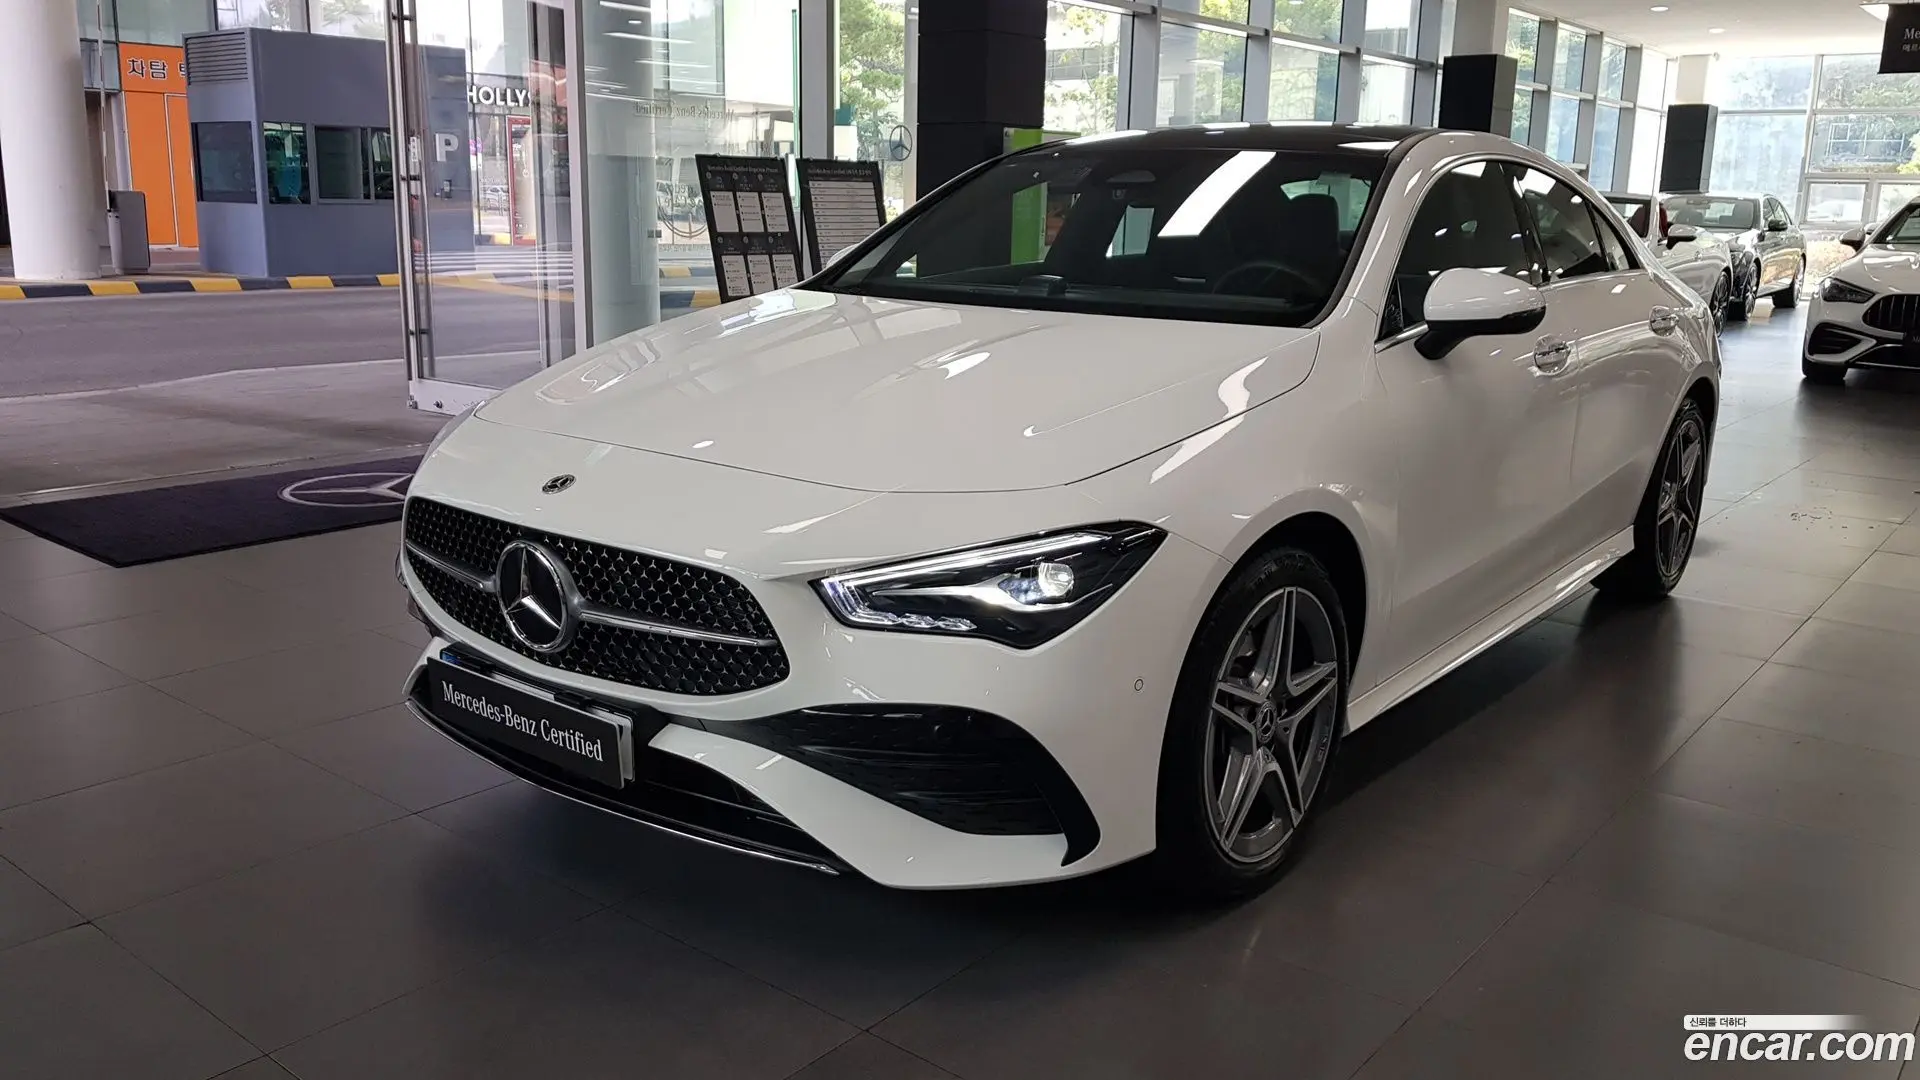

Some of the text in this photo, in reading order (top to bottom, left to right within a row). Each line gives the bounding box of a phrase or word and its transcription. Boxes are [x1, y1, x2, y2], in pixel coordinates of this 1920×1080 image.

[435, 132, 459, 162] P
[441, 680, 603, 762] Mercedes-Benz Certified
